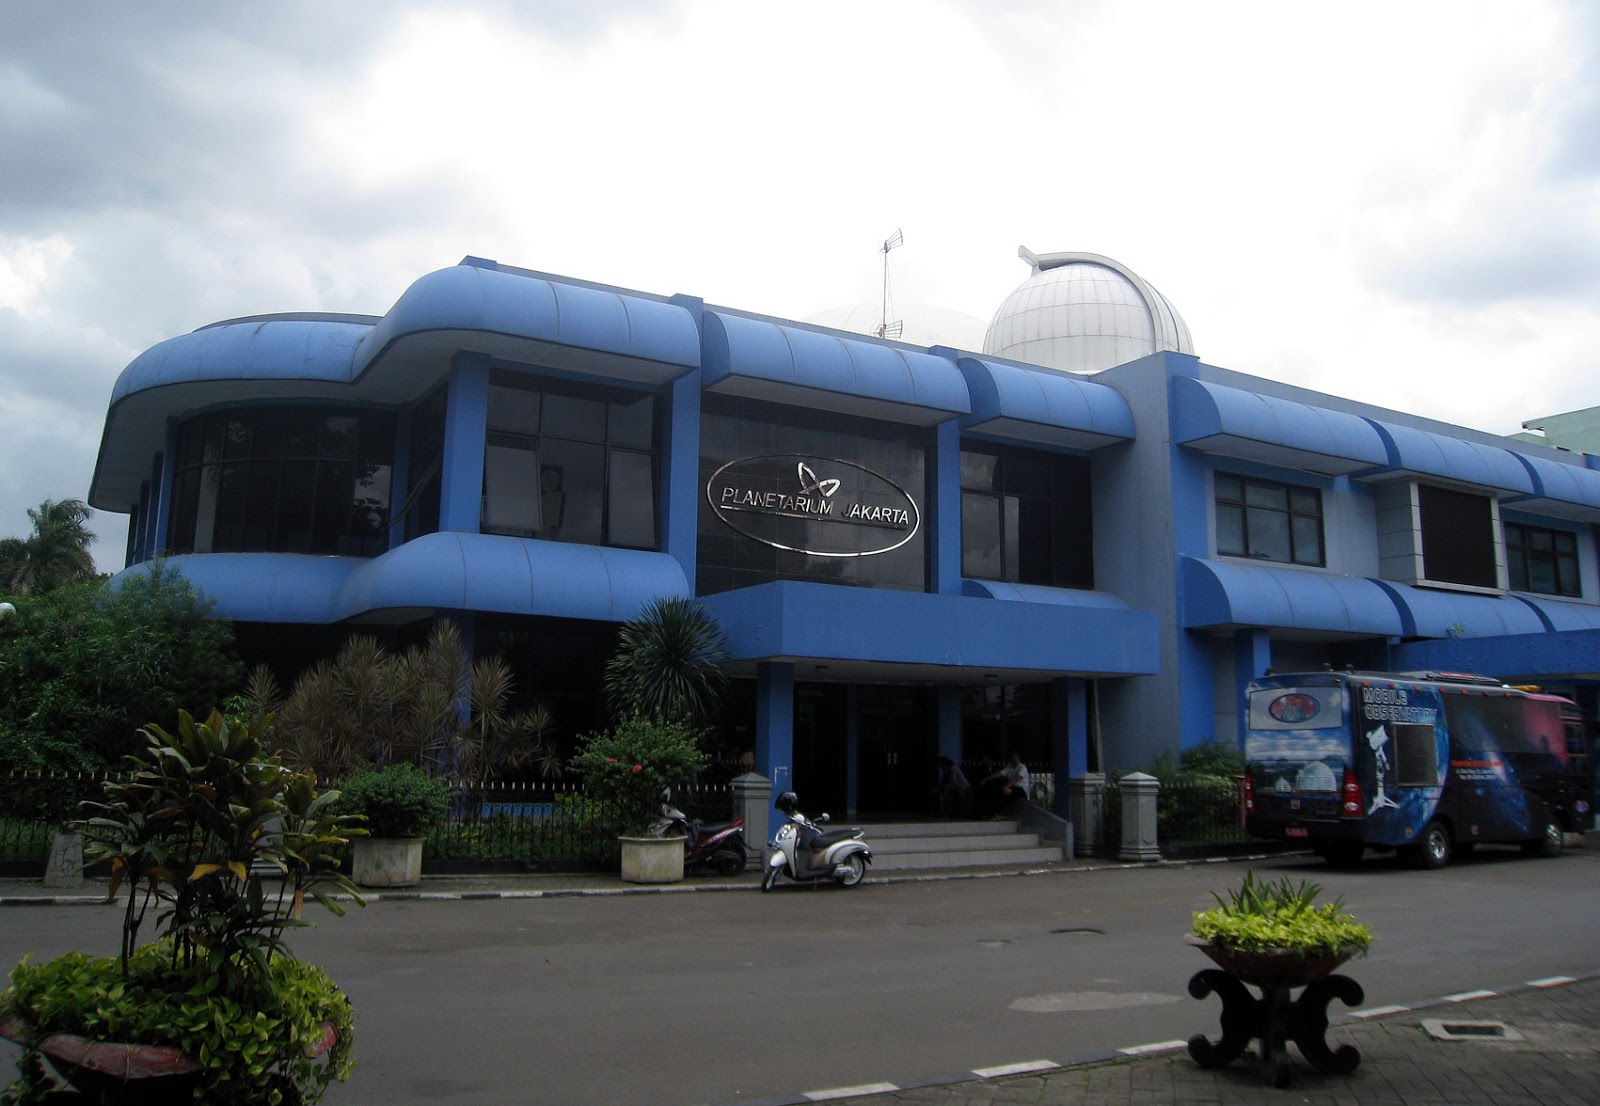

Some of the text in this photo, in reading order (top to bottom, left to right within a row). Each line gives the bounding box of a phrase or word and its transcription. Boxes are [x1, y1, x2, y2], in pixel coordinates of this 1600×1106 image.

[721, 487, 909, 525] PLANETARIUM JAKARTA
[1363, 687, 1408, 705] MOBILE
